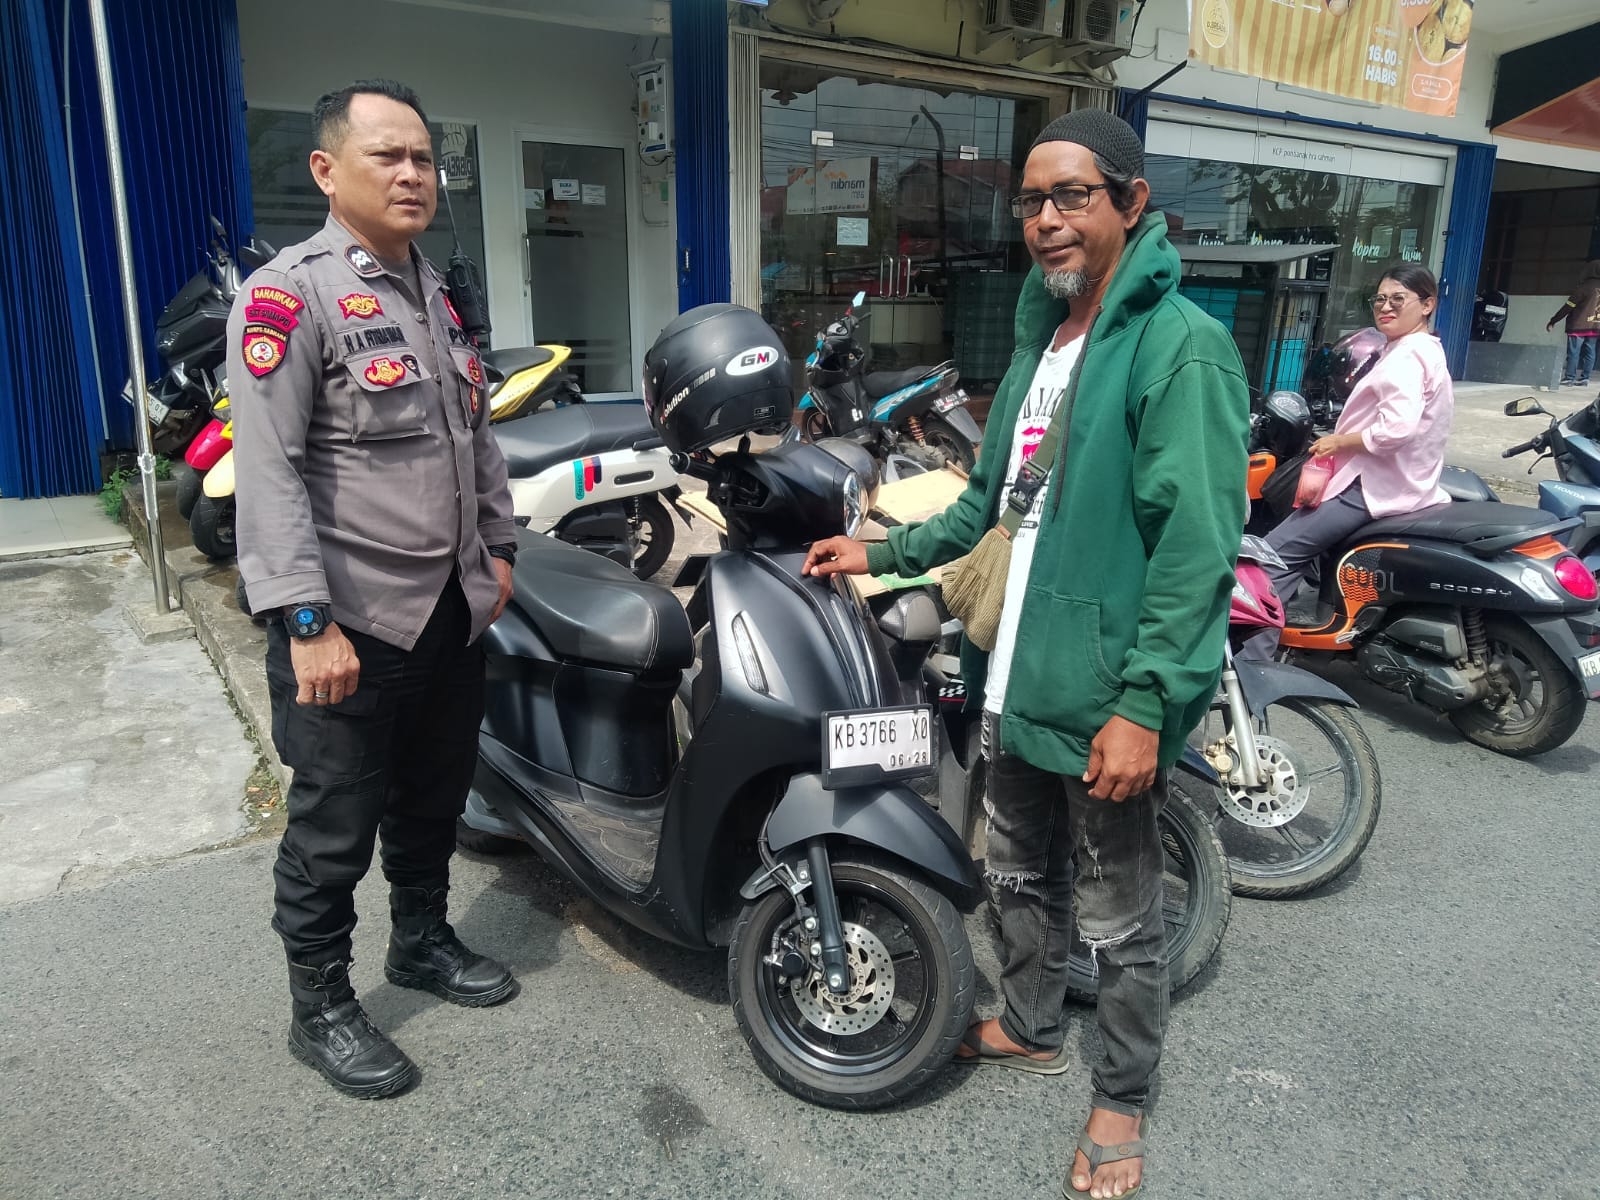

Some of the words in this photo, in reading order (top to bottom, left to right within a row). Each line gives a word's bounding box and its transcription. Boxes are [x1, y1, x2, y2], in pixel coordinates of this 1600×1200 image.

[1365, 64, 1397, 87] HABIS
[1352, 235, 1380, 262] kopra
[254, 288, 299, 310] BAHARKAM
[740, 351, 770, 367] GM
[1554, 484, 1585, 501] HONDA
[1429, 582, 1512, 598] SCOOPY
[1582, 660, 1598, 678] KB
[835, 724, 855, 750] KB
[860, 720, 896, 746] 3766
